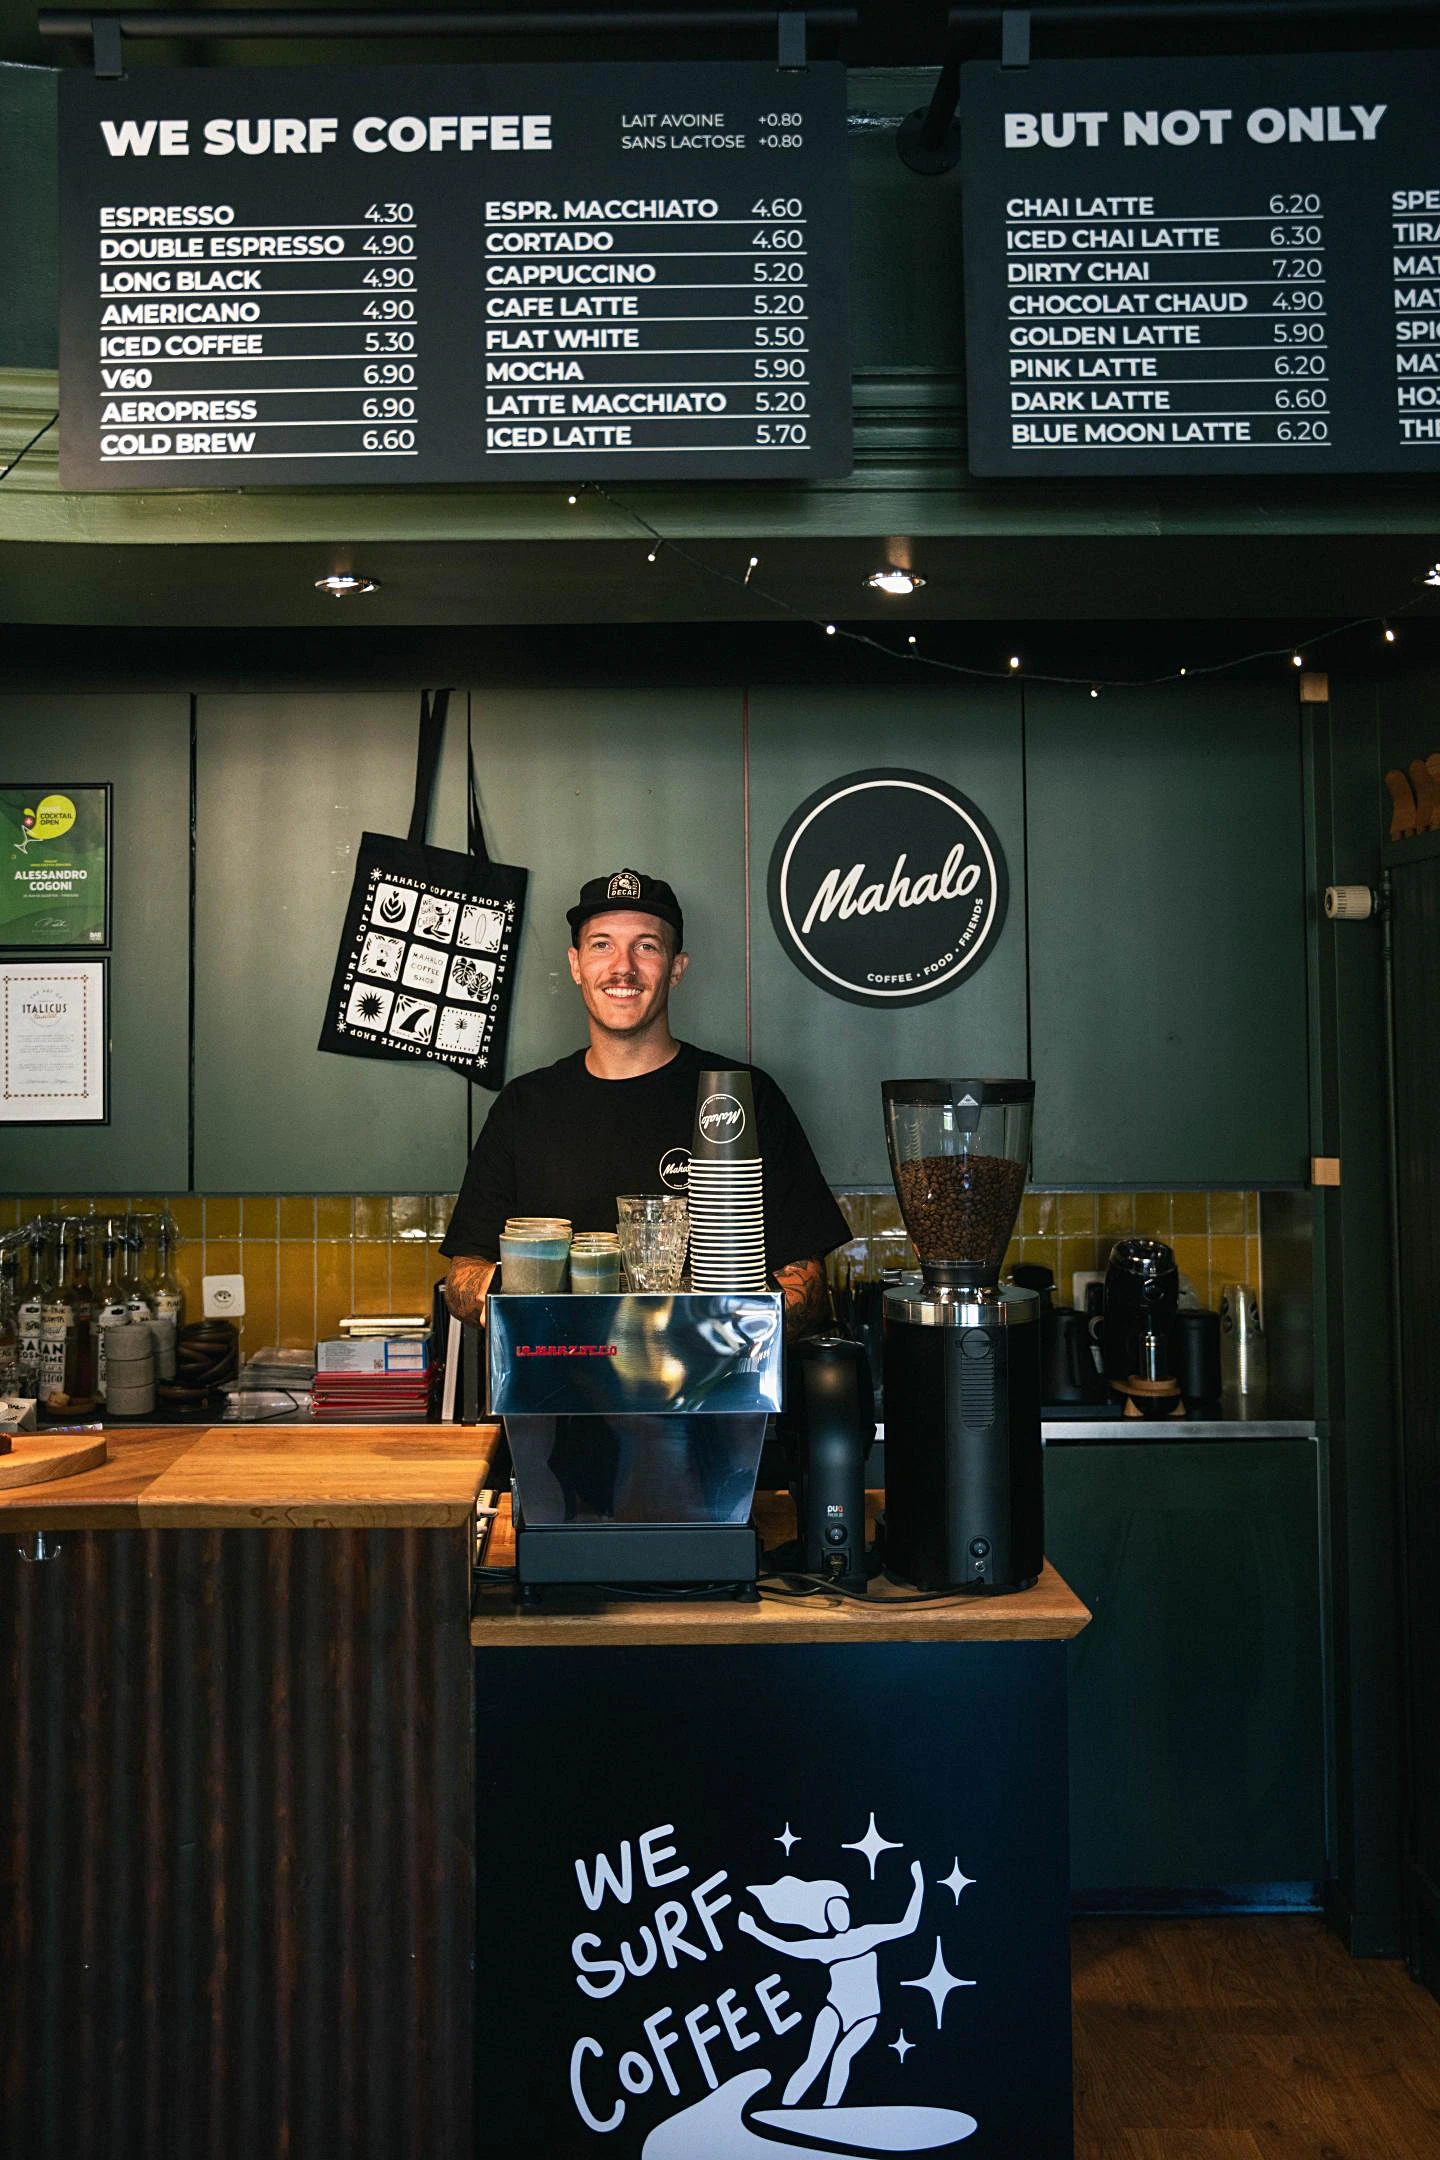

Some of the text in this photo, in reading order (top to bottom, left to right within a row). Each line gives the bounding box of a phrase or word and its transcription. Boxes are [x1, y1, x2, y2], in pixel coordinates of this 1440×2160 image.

[623, 113, 801, 127] LAIT AVOINE +0.80
[1005, 105, 1387, 147] BUT NOT ONLY
[101, 115, 552, 156] WE SURF COFFEE
[622, 135, 802, 149] SANS LACTOSE +0.80
[486, 199, 802, 220] ESPR. MACCHIATO 4.60
[1007, 194, 1319, 217] CHAI LATTE 6.20
[1392, 191, 1440, 210] SPE
[100, 203, 413, 227] ESPRESSO 4.30
[486, 230, 803, 252] CORTADO 4.60
[1007, 226, 1320, 249] ICED CHAI LATTE 6.30
[1393, 223, 1440, 242] TIR
[101, 235, 413, 259] DOUBLE ESPRESSO 4.90
[100, 268, 413, 292] LONG BLACK 4.90
[487, 263, 803, 285] CAPPUCCINO 5.20
[1008, 259, 1321, 282] DIRTY CHAI 7.20
[101, 300, 414, 324] AMERICANO 4.90
[487, 295, 804, 317] CAFE LATTE 5.20
[1009, 292, 1322, 314] CHOCOLAT CHAUD 4.90
[487, 327, 804, 349] FLAT WHITE 5.50
[1010, 324, 1323, 346] GOLDEN LATTE 5.90
[1396, 321, 1440, 340] SPI
[100, 332, 414, 357] ICED COFFEE 5.30
[101, 364, 414, 389] V60 6.90
[487, 359, 805, 381] MOCHA 5.90
[1011, 356, 1325, 377] PINK LATTE 6.20
[100, 398, 414, 422] AEROPRESS 6.90
[487, 392, 805, 415] LATTE MACCHIATO 5.20
[1012, 390, 1326, 410] DARK LATTE 6.60
[100, 429, 415, 455] COLD BREW 6.60
[487, 424, 806, 447] ICED LATTE 5.70
[1013, 422, 1327, 443] BLUE MOON LATTE 6.20
[40, 812, 73, 820] COCKTAIL
[14, 870, 88, 880] ALESSANDRO
[29, 881, 72, 891] COGONI
[385, 873, 500, 907] MAHALO COFFEE SHOP
[801, 842, 981, 934] Mahalo
[343, 951, 359, 992] SURF
[356, 883, 376, 942] COFFEE
[866, 898, 984, 984] COFFEE FOOD FRIENDS
[410, 962, 440, 976] COFFEE
[413, 952, 444, 966] MAHALO
[496, 943, 509, 983] SURF
[22, 1003, 68, 1014] ITALICUS
[482, 994, 500, 1053] COFFEE
[574, 1823, 690, 1911] WE
